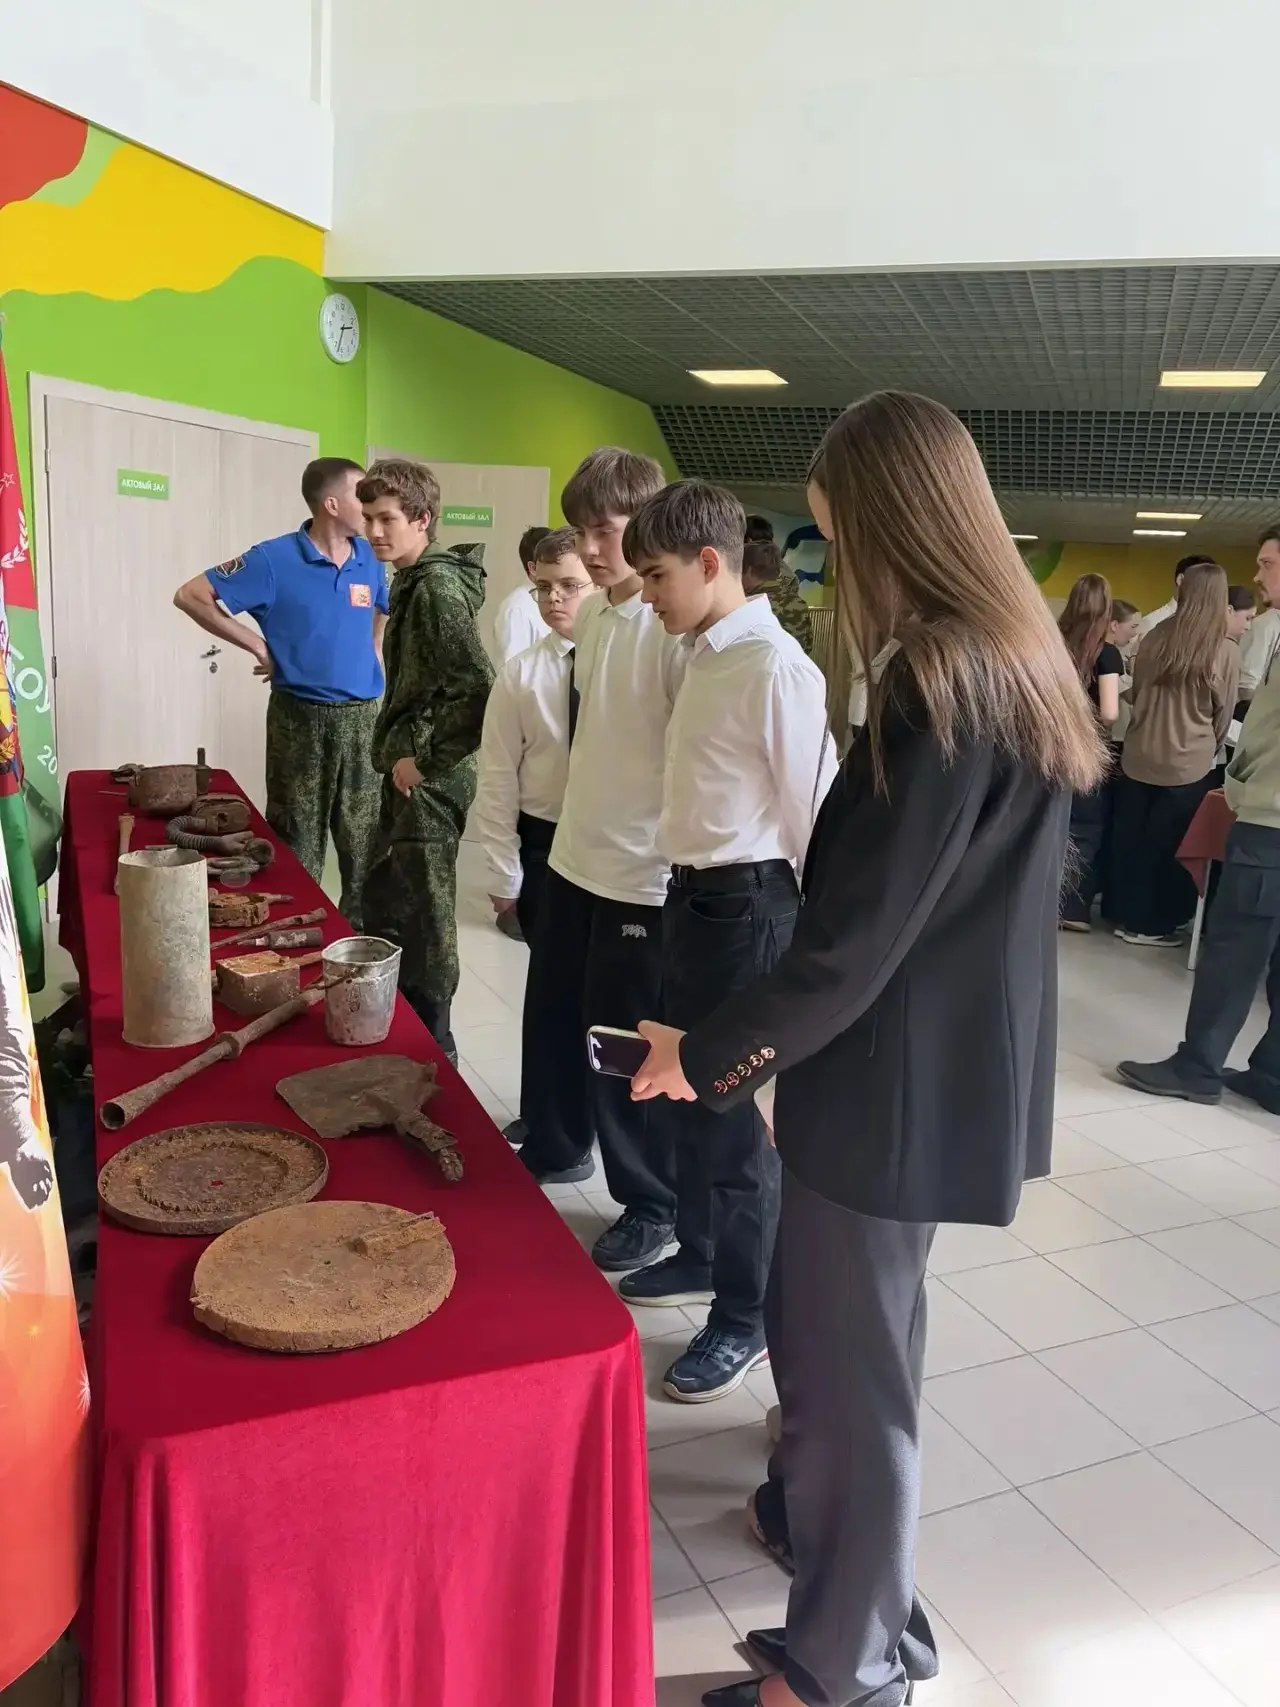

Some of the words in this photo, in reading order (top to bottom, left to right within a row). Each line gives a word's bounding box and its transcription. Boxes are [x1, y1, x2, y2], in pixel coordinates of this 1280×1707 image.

[121, 478, 152, 491] АКТОВЫЙ
[152, 482, 166, 492] ЗАЛ
[446, 512, 476, 520] АКТОВЫЙ
